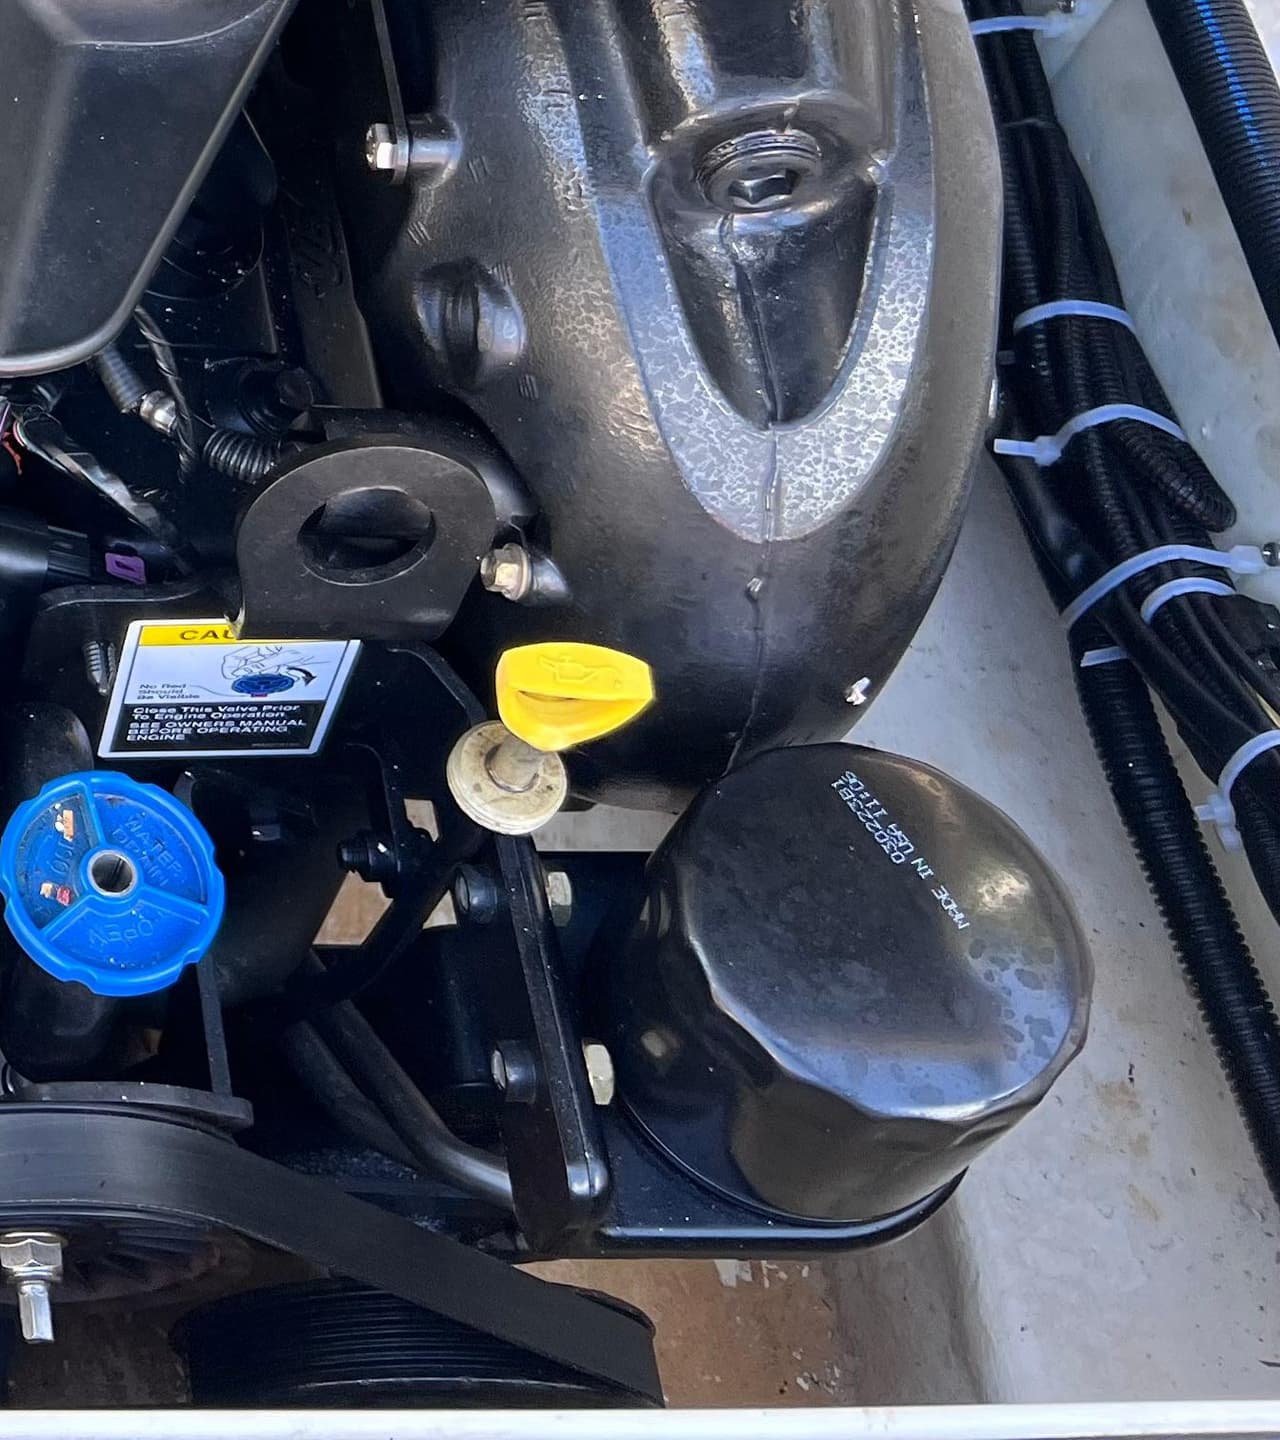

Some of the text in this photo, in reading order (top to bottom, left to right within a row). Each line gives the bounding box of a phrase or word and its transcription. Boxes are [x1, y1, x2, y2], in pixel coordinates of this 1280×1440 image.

[133, 706, 177, 714] Close
[154, 712, 207, 721] Engine
[210, 711, 286, 720] Operation
[164, 720, 235, 728] OWNERS
[127, 726, 288, 735] BEFORE OPERATING
[886, 822, 915, 855] USA
[910, 857, 935, 881] IN
[930, 884, 971, 931] MADE
